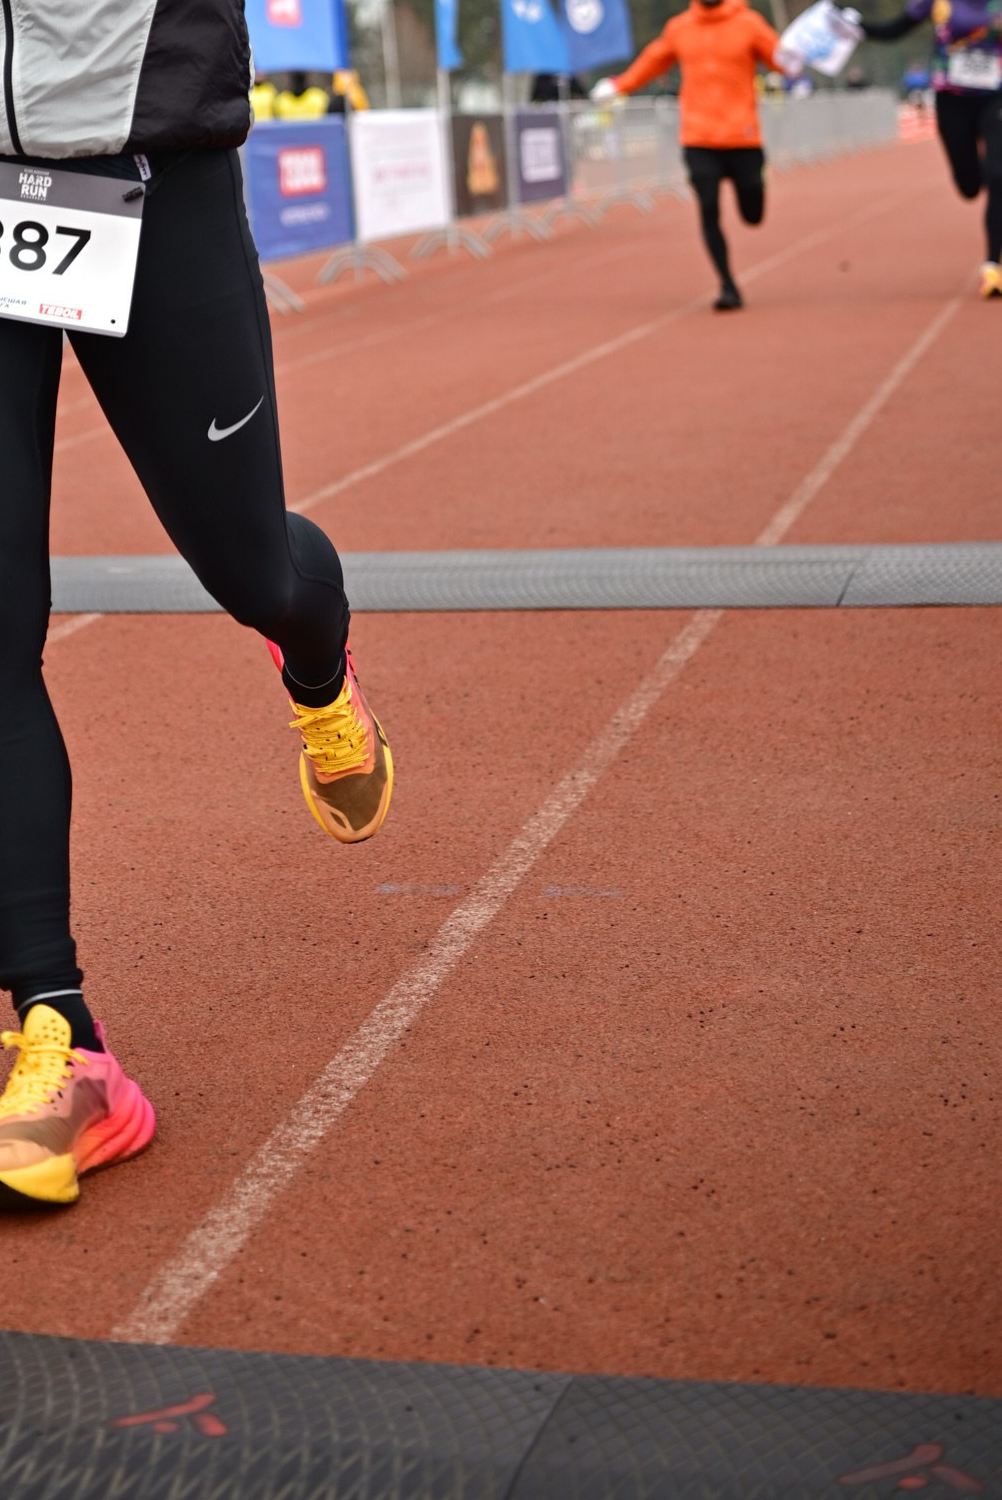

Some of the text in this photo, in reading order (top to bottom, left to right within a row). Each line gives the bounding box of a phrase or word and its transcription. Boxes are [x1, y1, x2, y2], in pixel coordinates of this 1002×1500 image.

[18, 172, 53, 188] HARD
[21, 184, 48, 198] RUN
[40, 303, 82, 320] TEBOIL
